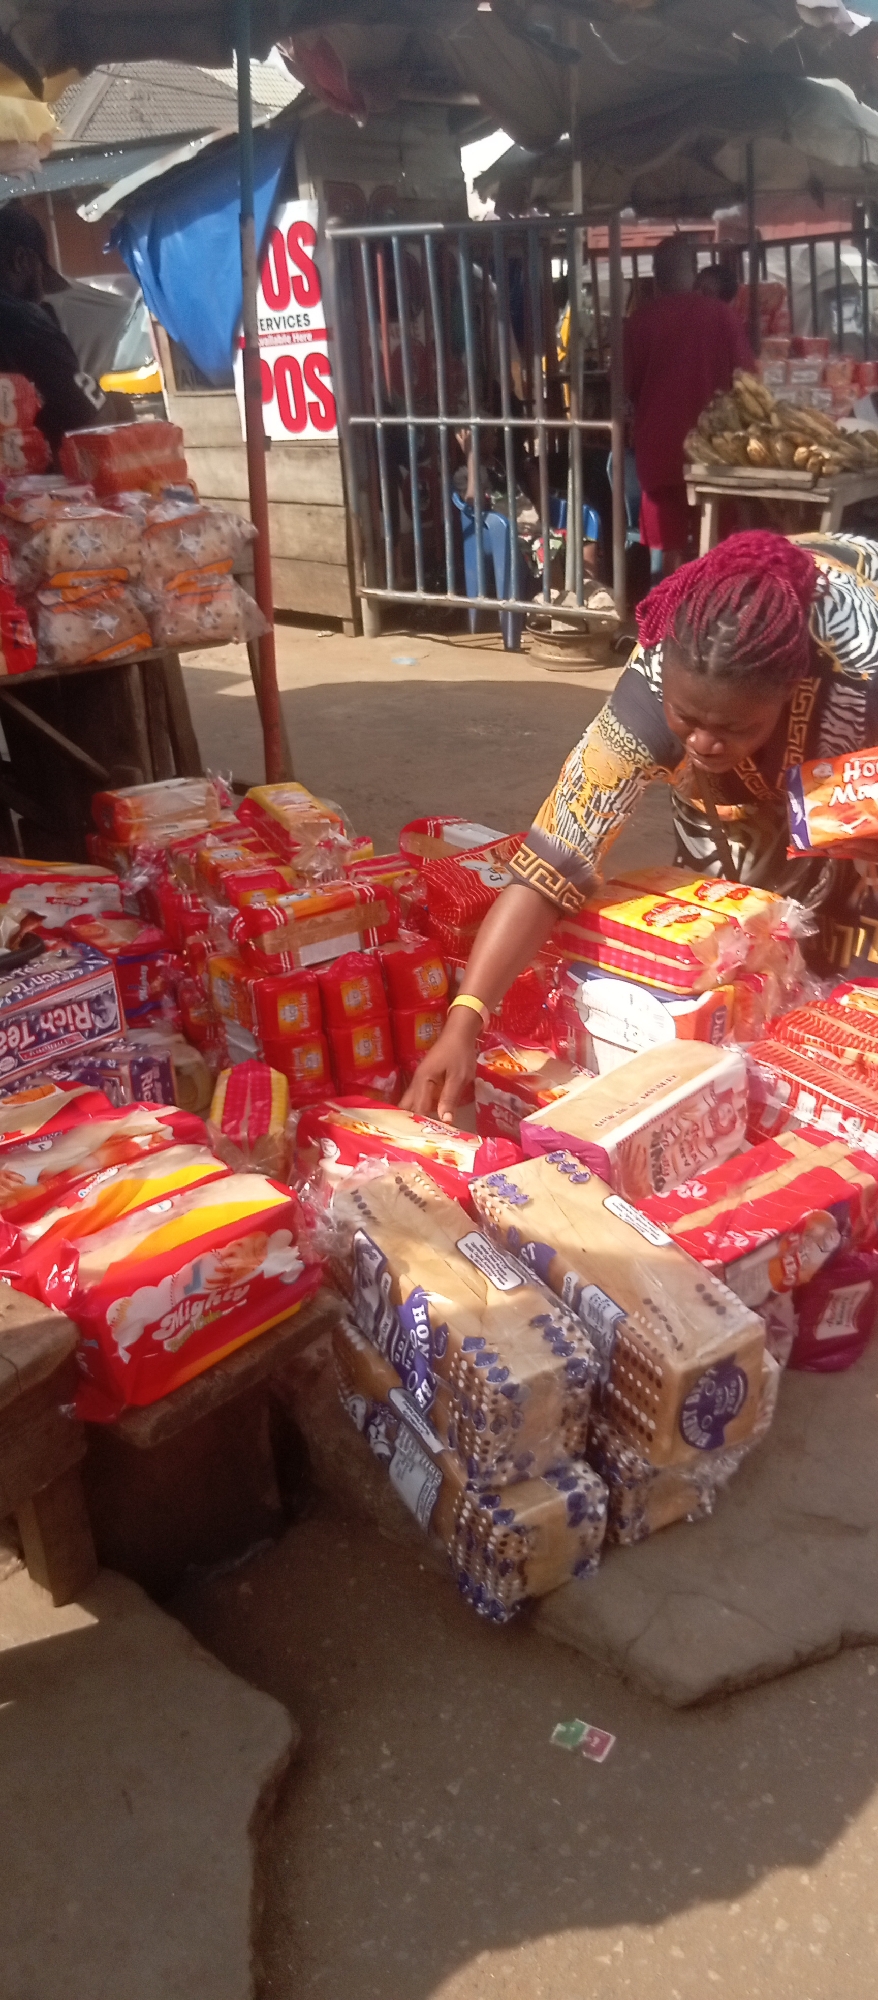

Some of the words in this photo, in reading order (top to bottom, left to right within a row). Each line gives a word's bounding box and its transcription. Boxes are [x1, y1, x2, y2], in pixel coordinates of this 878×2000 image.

[260, 220, 322, 312] OS
[259, 313, 311, 332] ERVICES
[258, 333, 291, 347] vailable
[843, 760, 878, 783] Ho
[40, 1001, 94, 1034] Rich
[140, 1070, 154, 1103] Ric
[152, 1285, 250, 1340] Mighty
